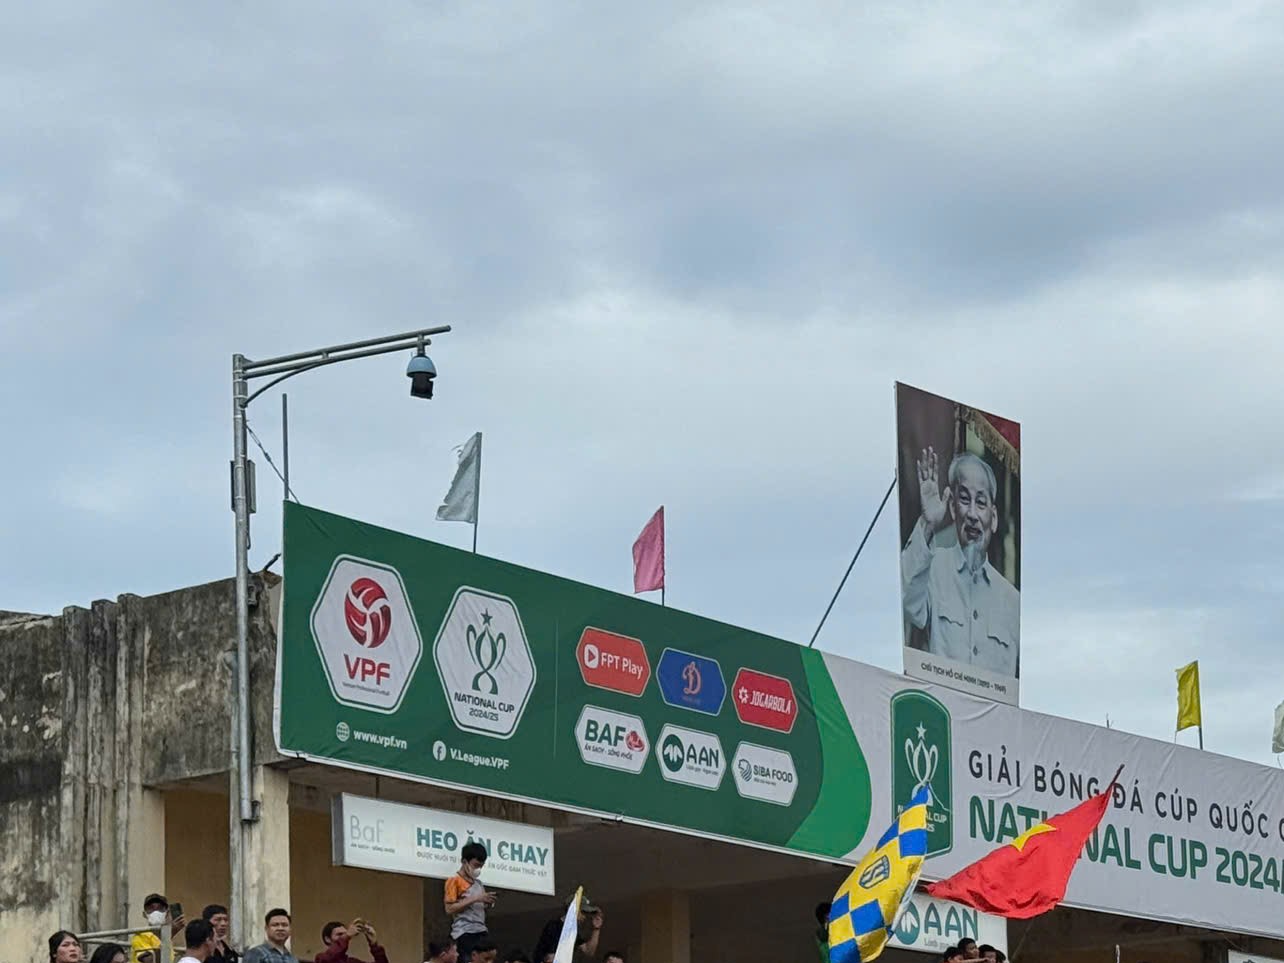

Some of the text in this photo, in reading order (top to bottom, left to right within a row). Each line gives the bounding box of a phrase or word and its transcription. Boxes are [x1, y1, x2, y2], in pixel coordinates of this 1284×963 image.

[343, 653, 390, 686] VPF
[601, 652, 644, 680] FPT Play
[454, 692, 515, 714] NATIONAL CUP
[469, 708, 499, 722] 2024/25
[353, 729, 407, 750] www.vpf.vn
[585, 719, 626, 747] BAF
[450, 748, 510, 770] V.League.VPF
[686, 744, 719, 768] AAN
[753, 765, 771, 779] SIBA
[772, 770, 793, 783] FOOD
[968, 745, 1021, 788] GIẢI
[1034, 762, 1100, 801] BÓNG
[1112, 779, 1144, 814] ĐÁ
[1155, 788, 1198, 823] CÚP
[1209, 800, 1269, 839] QUỐC
[416, 827, 458, 851] HEO
[497, 840, 549, 866] CHAY
[969, 795, 1142, 871] NATNAL
[1148, 833, 1208, 880] CUP
[924, 902, 979, 941] AAN
